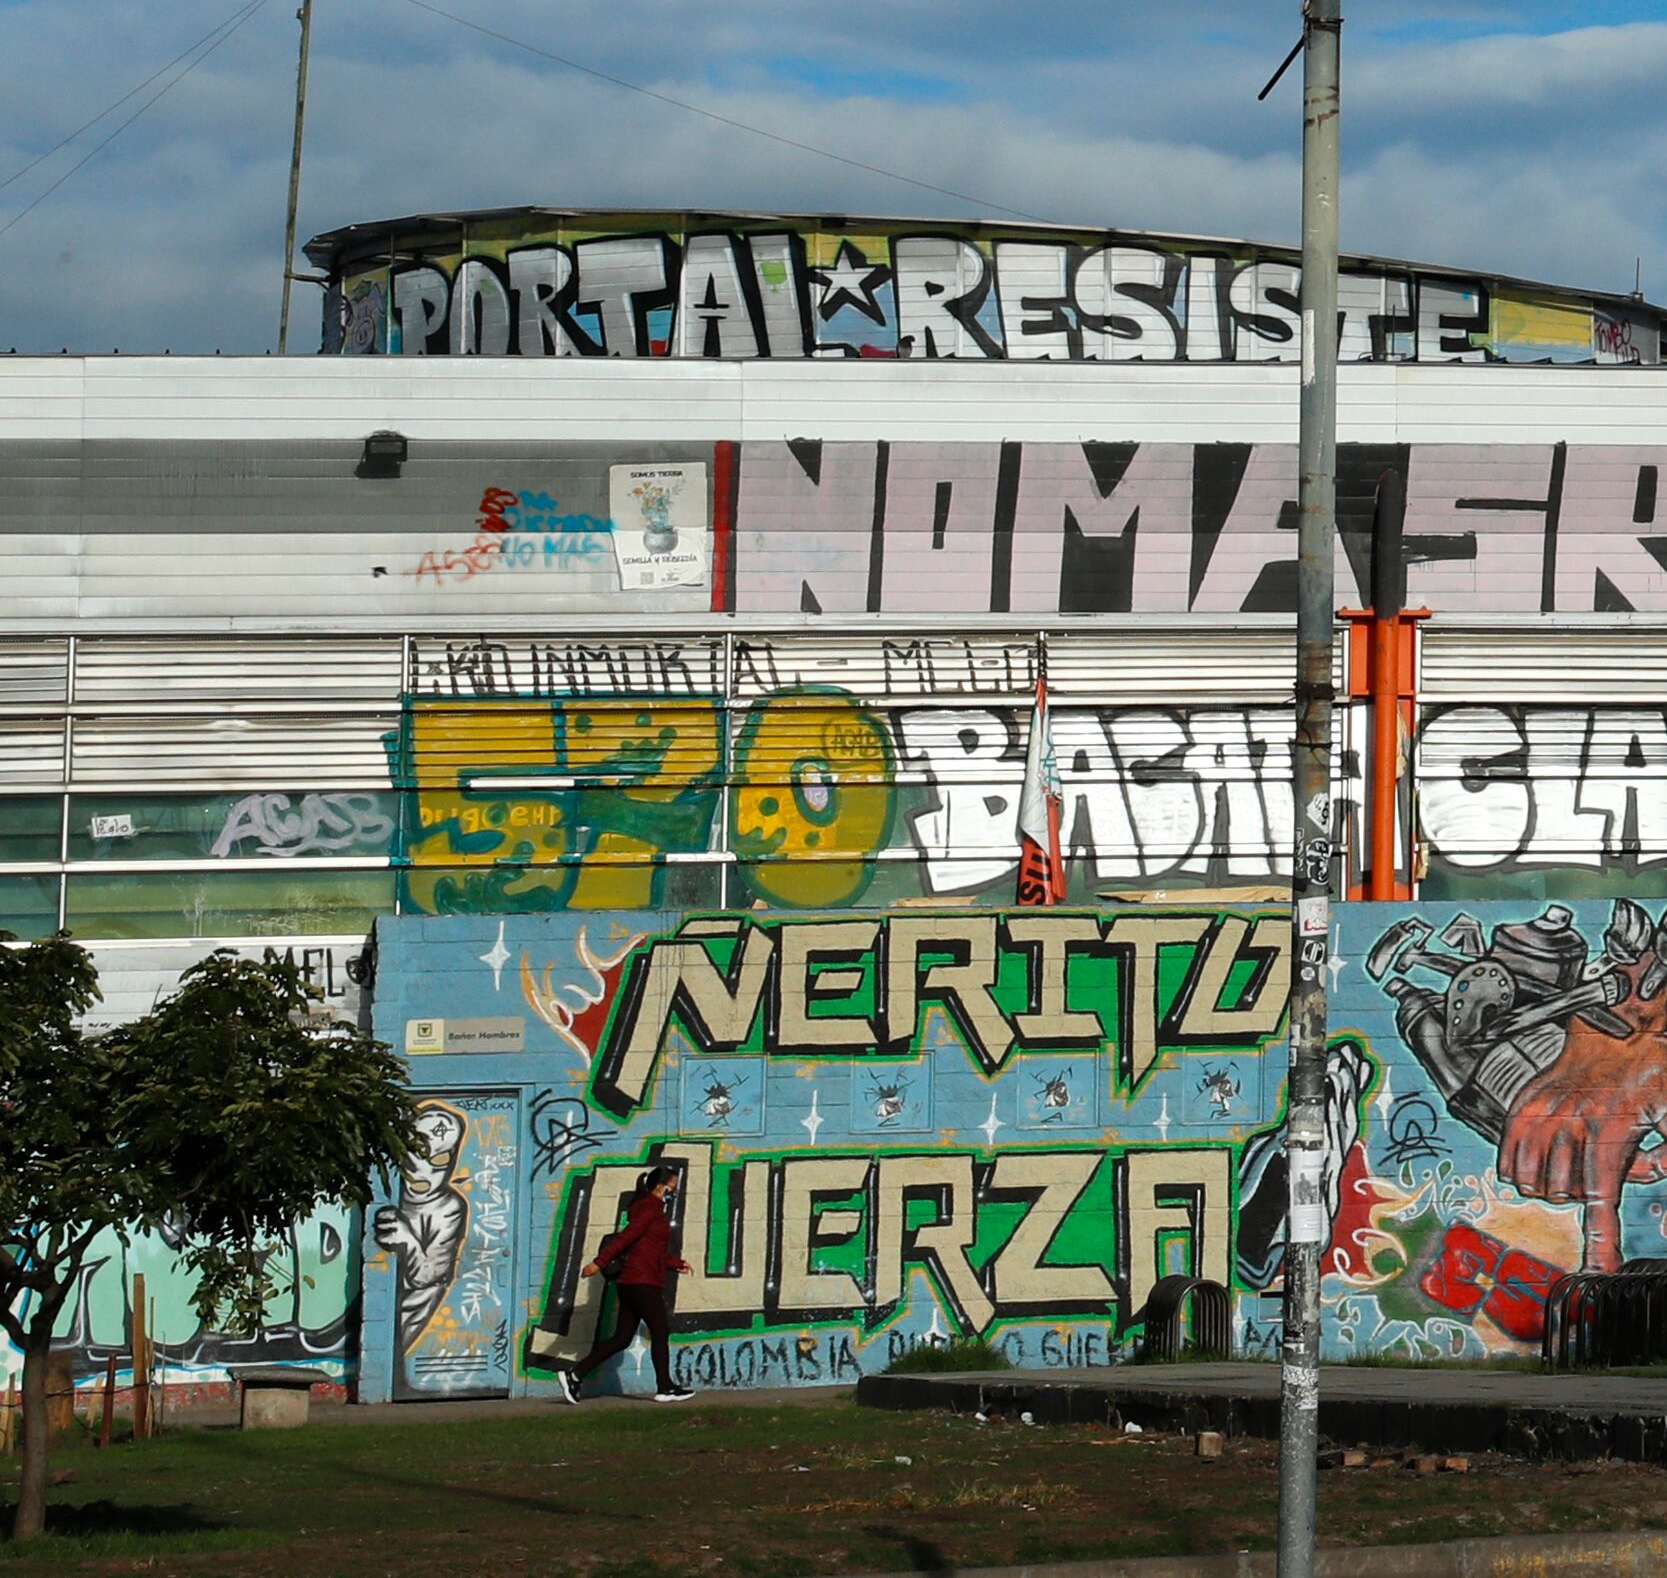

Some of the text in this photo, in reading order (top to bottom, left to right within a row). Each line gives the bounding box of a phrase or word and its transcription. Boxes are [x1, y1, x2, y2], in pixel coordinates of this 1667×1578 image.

[397, 230, 1490, 360] PORTAL RESISTE
[630, 470, 656, 479] SOMOS
[622, 557, 652, 565] SEMILLA
[478, 1031, 521, 1040] Hombres
